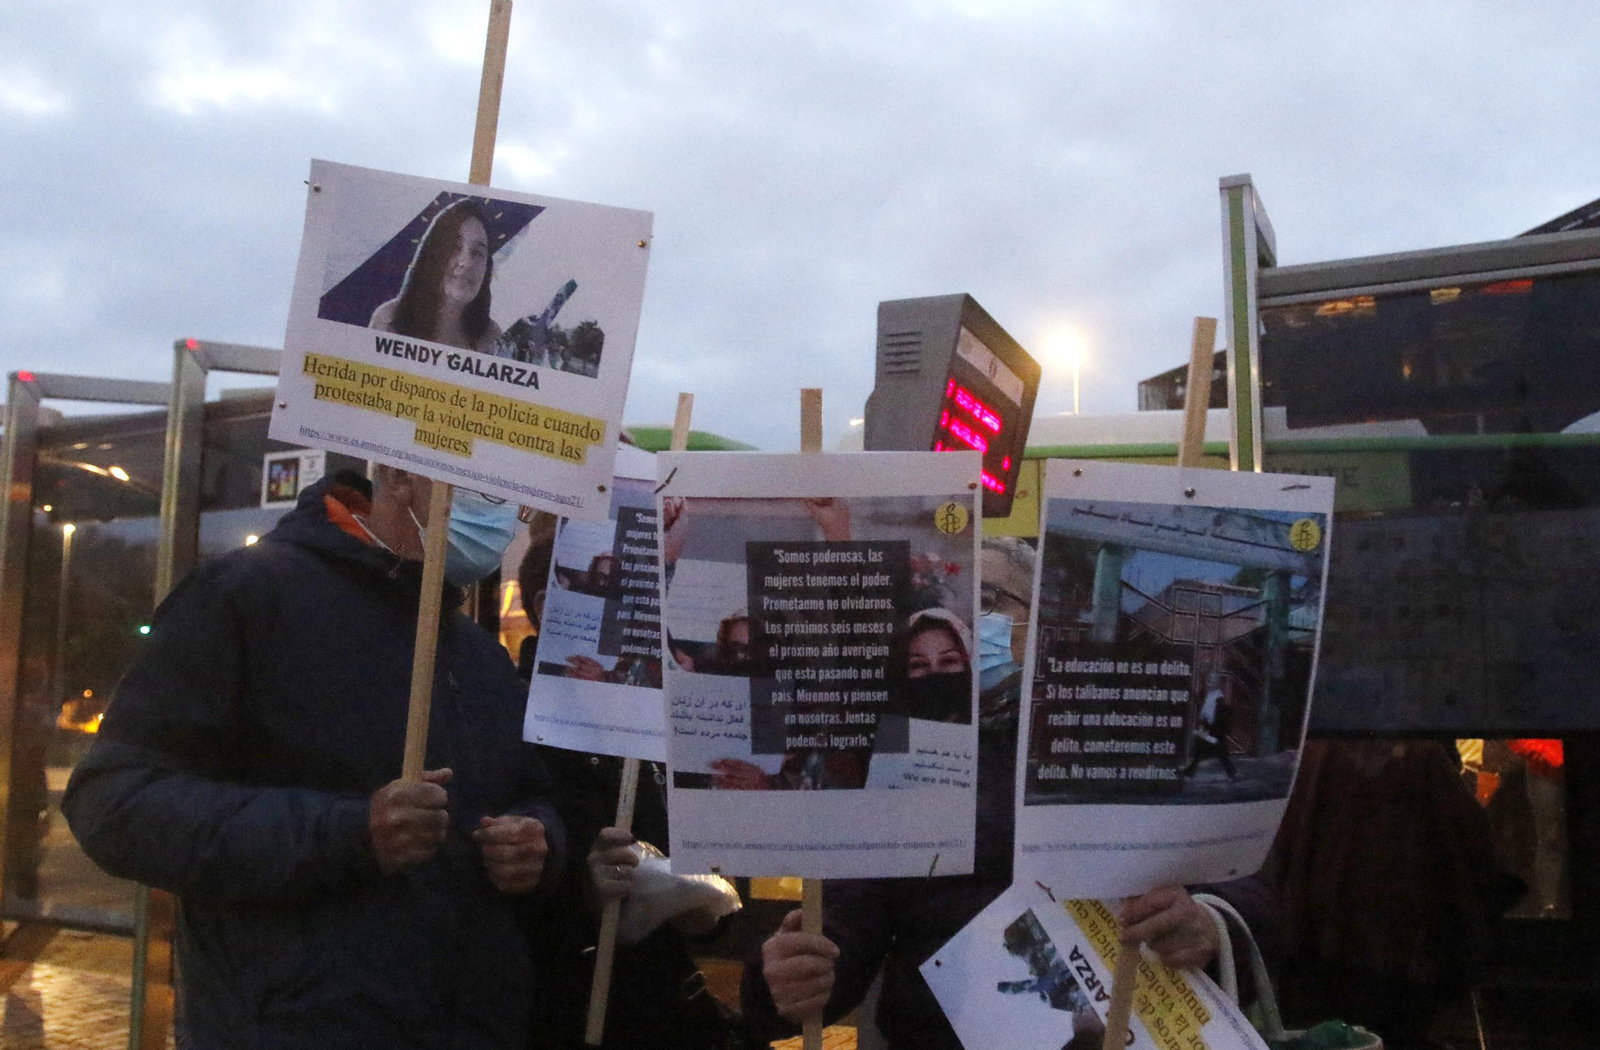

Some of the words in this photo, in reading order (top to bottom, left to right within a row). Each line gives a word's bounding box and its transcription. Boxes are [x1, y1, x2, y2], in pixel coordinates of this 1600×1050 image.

[375, 336, 443, 366] WENDY
[447, 353, 540, 390] GALARZA
[303, 355, 357, 381] Herida
[360, 371, 387, 388] por
[389, 375, 446, 404] disparos
[450, 390, 467, 408] de
[471, 394, 485, 413] la
[488, 400, 539, 427] policía
[543, 415, 600, 442] cuando
[314, 383, 393, 411] protestaba
[395, 401, 420, 418] por
[423, 404, 435, 422] la
[439, 410, 504, 440] violencia
[508, 429, 555, 454] contra
[559, 438, 582, 460] las
[414, 426, 472, 455] mujeres.
[813, 550, 866, 565] poderosas,
[868, 549, 883, 563] las
[764, 574, 804, 590] mujeres
[806, 573, 848, 587] tenemos
[851, 572, 860, 586] el
[862, 572, 893, 588] poder.
[763, 596, 824, 611] Prométanme
[827, 598, 839, 610] no
[841, 596, 895, 610] olvidarnos.
[765, 621, 782, 634] Los
[831, 620, 851, 634] seis
[853, 621, 884, 634] meses
[887, 622, 894, 634] o
[769, 644, 778, 657] el
[822, 643, 839, 657] año
[842, 643, 890, 660] averigüen
[818, 666, 859, 682] pasando
[861, 668, 873, 680] en
[875, 666, 885, 679] el
[1117, 661, 1129, 674] no
[1131, 661, 1143, 675] es
[1145, 662, 1158, 675] un
[797, 688, 840, 703] Mirennos
[843, 691, 850, 705] y
[851, 689, 889, 704] piensen
[1046, 684, 1055, 700] Si
[1058, 684, 1073, 700] los
[1075, 684, 1121, 700] talibanes
[1123, 685, 1168, 702] anuncian
[1170, 689, 1190, 705] que
[784, 713, 796, 725] en
[798, 712, 843, 725] nosotras.
[845, 711, 876, 725] Juntas
[1048, 710, 1081, 726] recibir
[1082, 713, 1100, 727] una
[1156, 714, 1168, 728] es
[1170, 715, 1183, 729] un
[786, 734, 828, 750] podems
[1083, 738, 1151, 755] cometeremos
[1153, 739, 1176, 755] este
[1037, 763, 1069, 780] delito.
[1071, 763, 1084, 779] No
[1086, 765, 1118, 780] vamos
[1119, 767, 1127, 780] a
[1139, 953, 1175, 1013] violen
[1138, 993, 1155, 1015] de
[1161, 965, 1211, 1026] mujere
[1175, 1014, 1191, 1035] la
